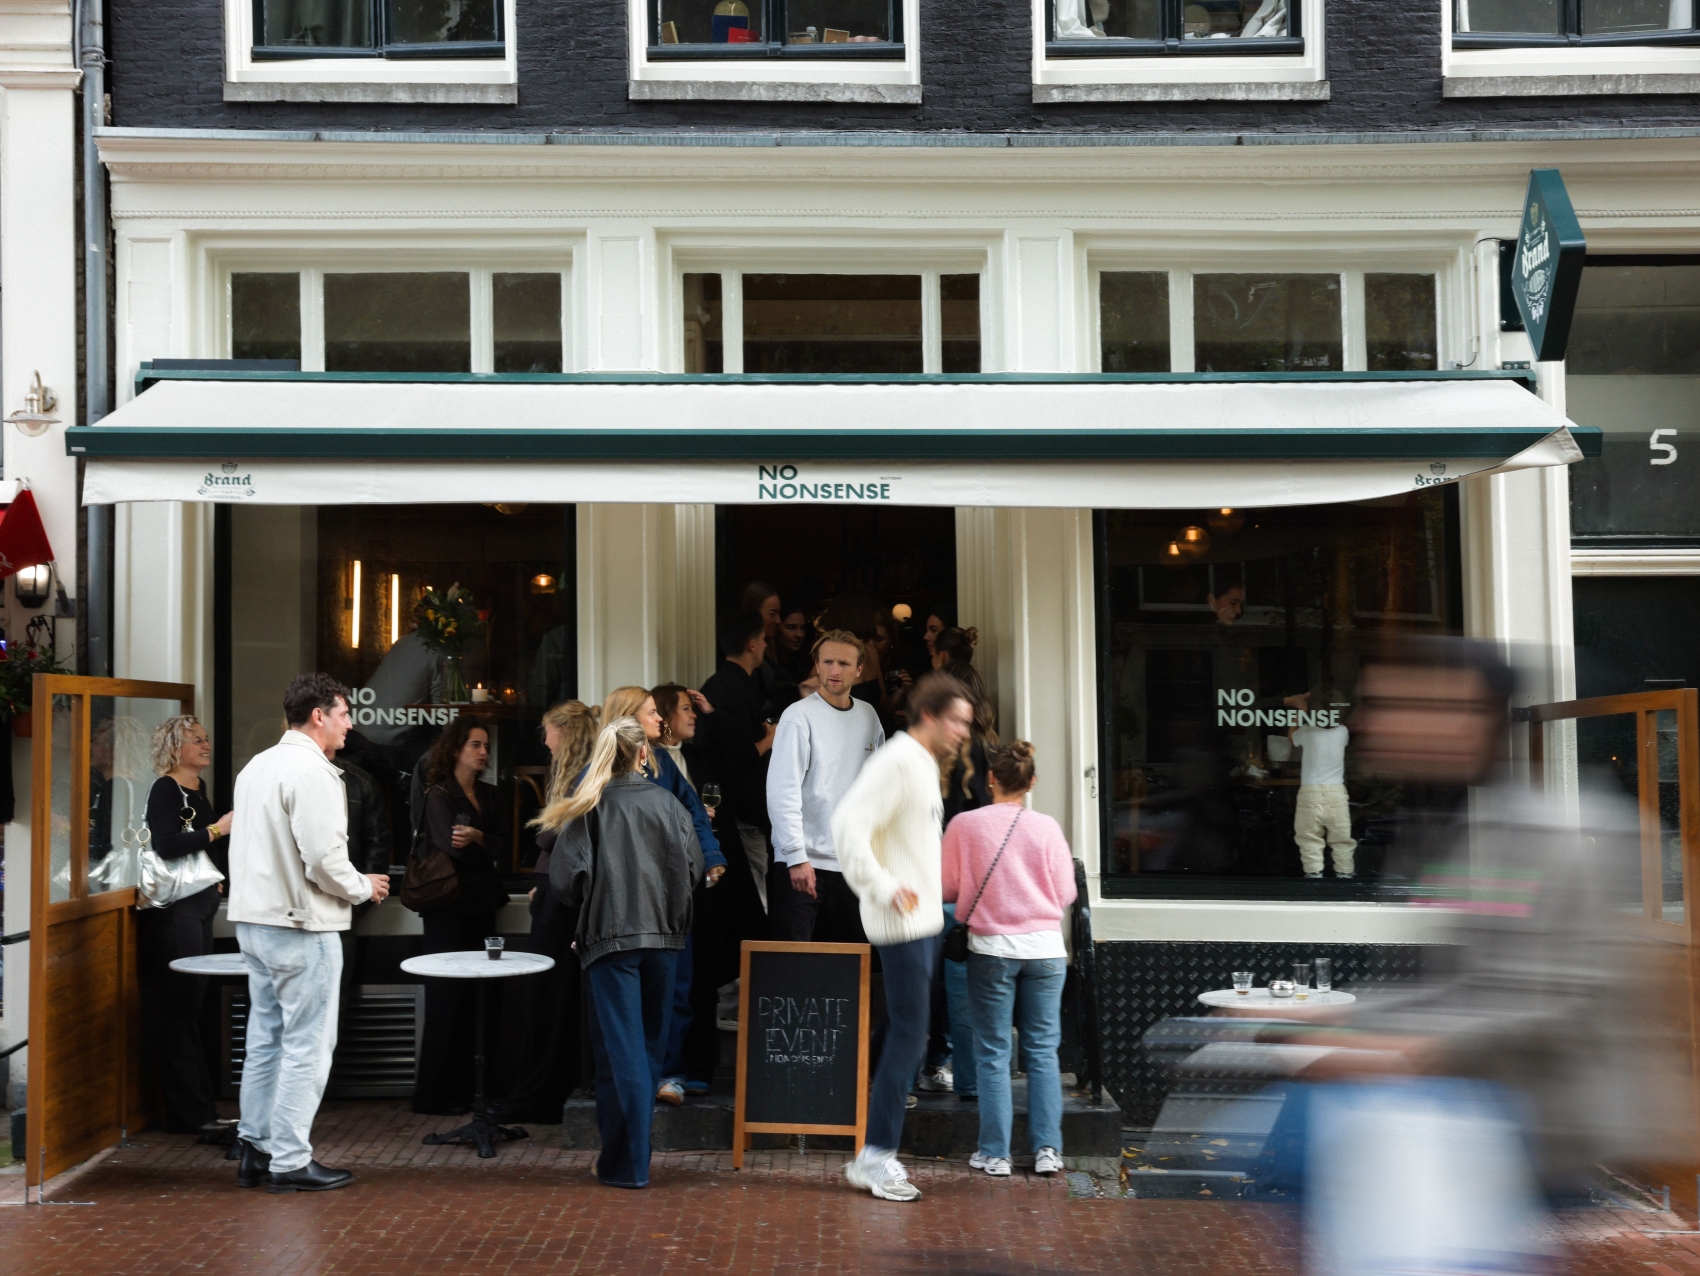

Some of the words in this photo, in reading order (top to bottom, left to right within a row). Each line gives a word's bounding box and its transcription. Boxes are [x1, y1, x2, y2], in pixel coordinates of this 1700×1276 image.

[1522, 231, 1550, 278] Brand
[204, 472, 251, 486] Brand
[758, 465, 798, 481] NO
[1414, 473, 1461, 486] Bra
[758, 483, 890, 500] NONSENSE
[1217, 688, 1255, 706] NO
[1217, 709, 1340, 727] NONSENSE
[758, 996, 850, 1028] PRIVATE
[765, 1028, 843, 1056] EVENT
